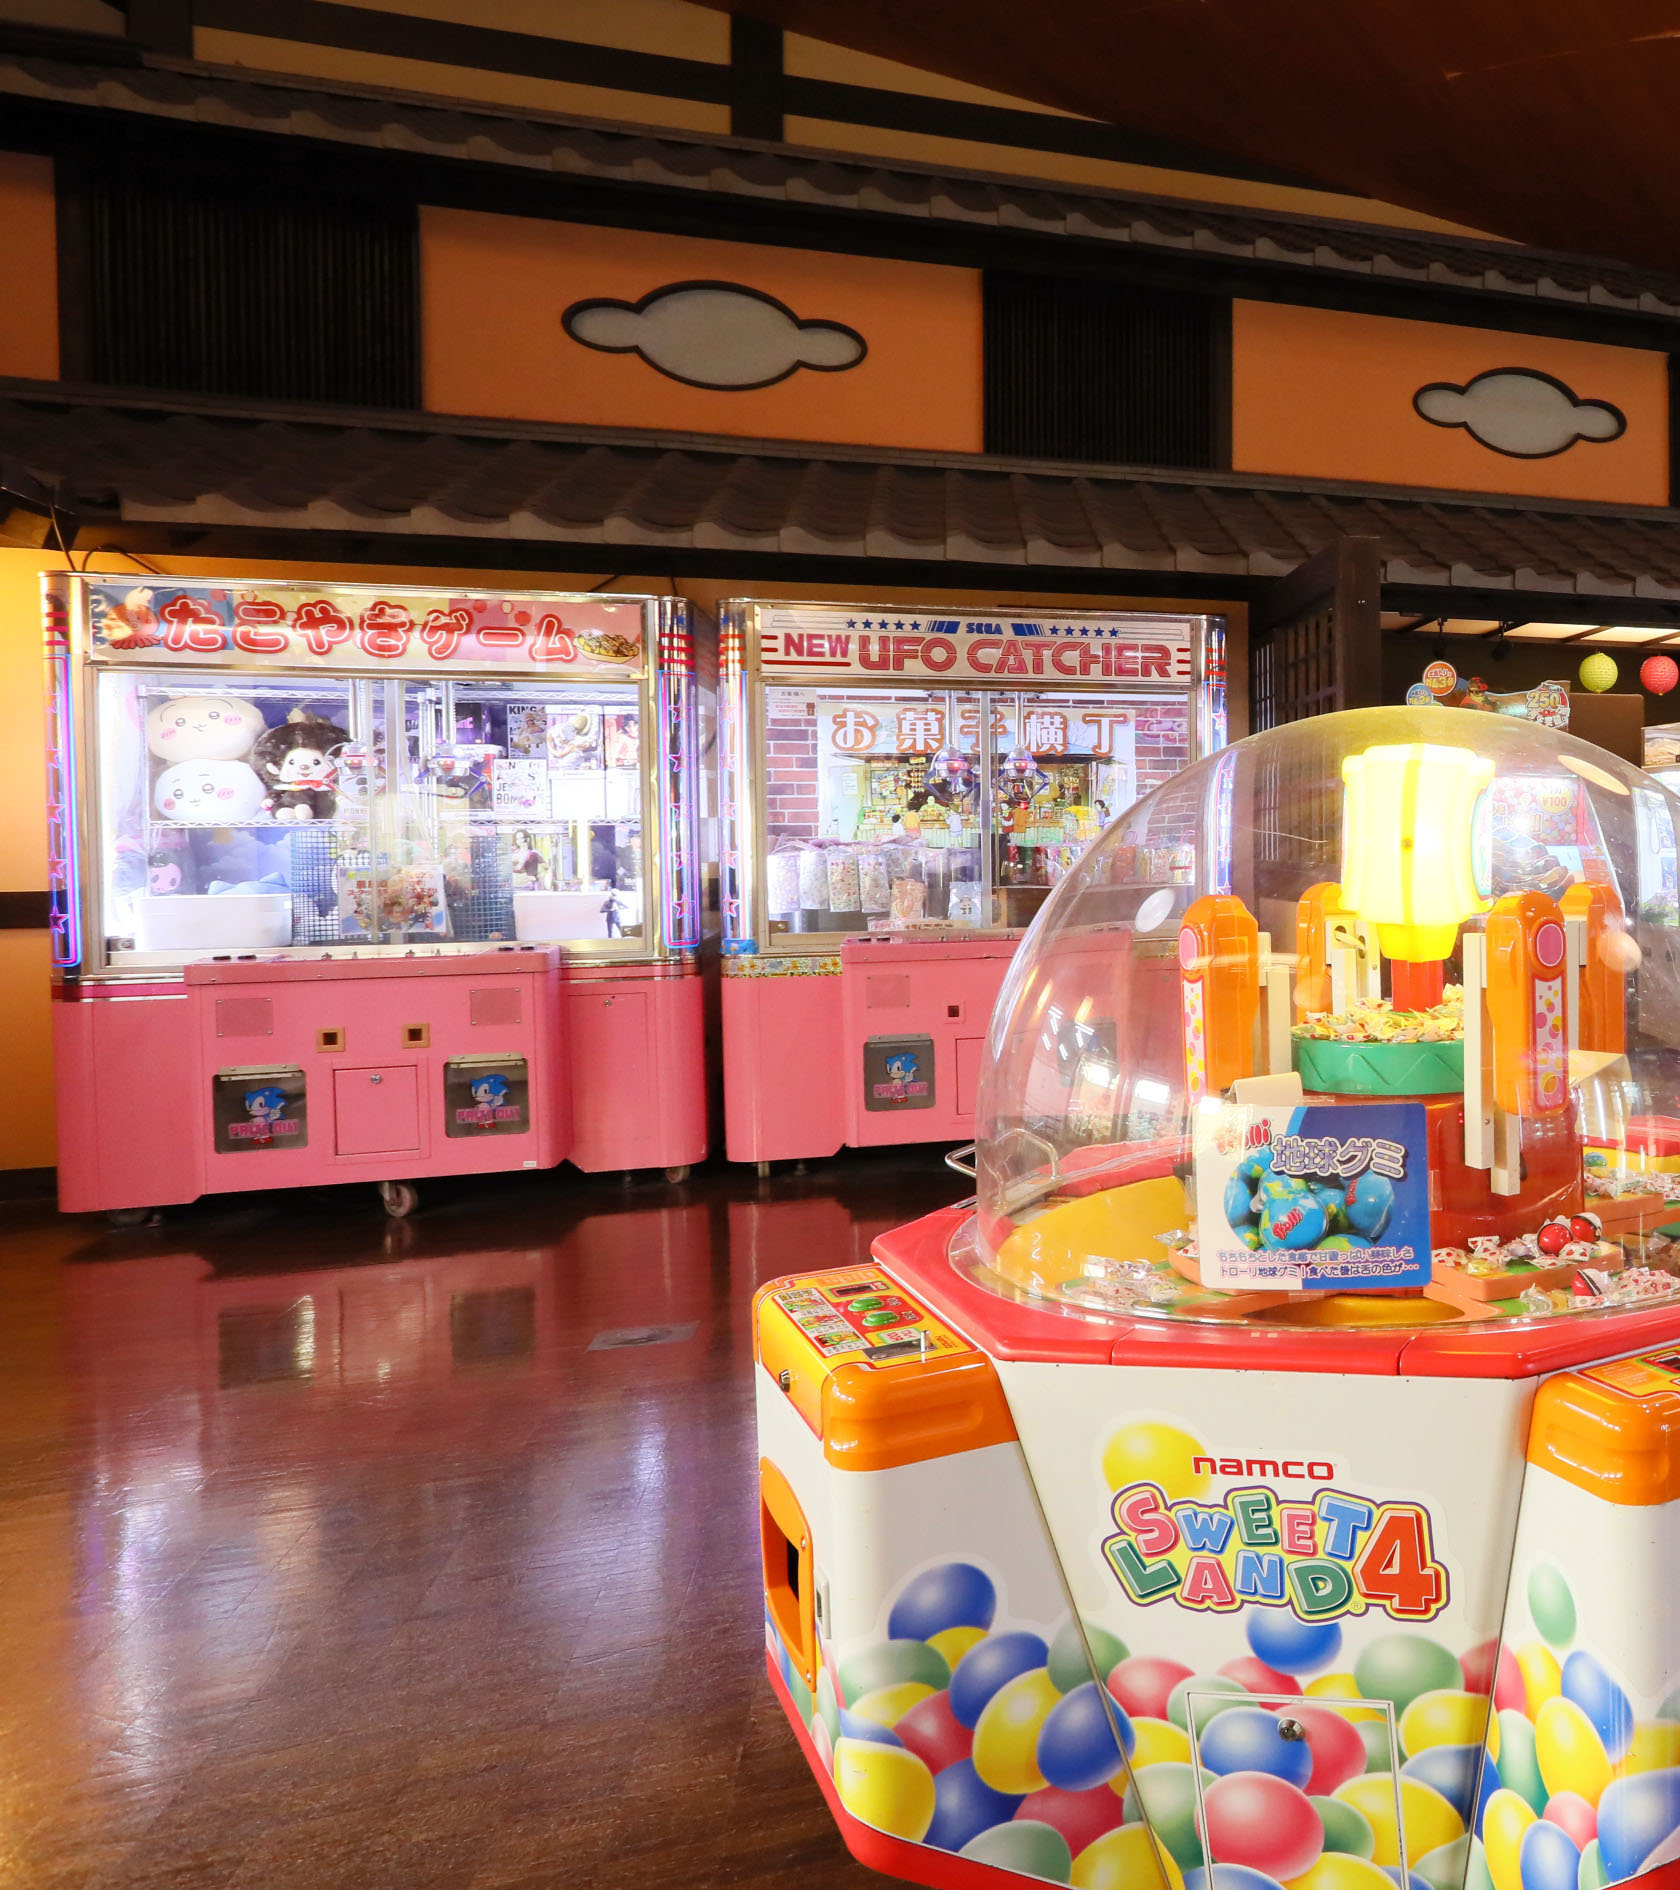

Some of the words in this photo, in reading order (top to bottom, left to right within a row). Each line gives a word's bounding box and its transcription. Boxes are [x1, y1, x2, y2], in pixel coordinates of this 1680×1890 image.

[160, 595, 578, 661] たこやきゲーム
[966, 622, 1004, 635] SEGA
[783, 632, 850, 659] NEW
[858, 635, 957, 672] UFO
[966, 639, 1172, 678] CATCHER
[1527, 691, 1561, 709] 250
[831, 708, 1128, 756] お菓子横丁
[908, 1081, 928, 1096] OUT
[274, 1119, 300, 1135] OUT
[496, 1106, 521, 1120] OUT
[1271, 1134, 1408, 1180] 地球グミ
[1272, 1207, 1304, 1241] Trolli
[1192, 1456, 1335, 1481] namco
[1117, 1490, 1375, 1561] SWEET
[1351, 1508, 1445, 1615] 4
[1110, 1536, 1353, 1614] LAND
